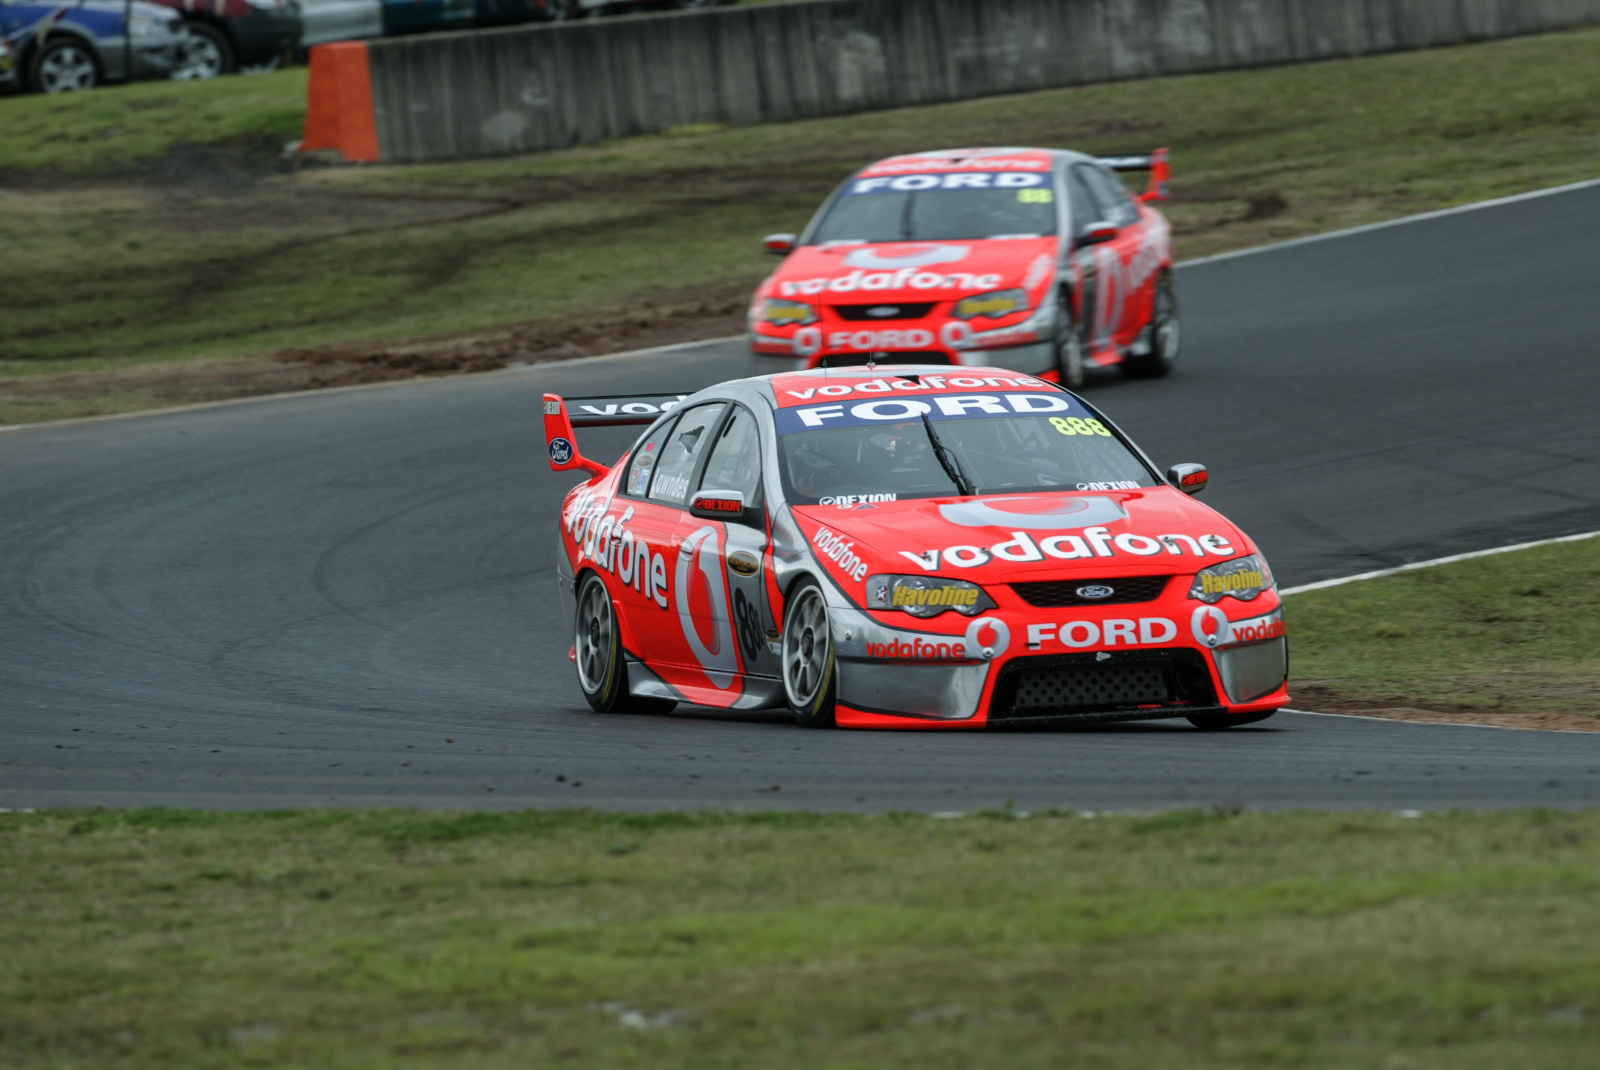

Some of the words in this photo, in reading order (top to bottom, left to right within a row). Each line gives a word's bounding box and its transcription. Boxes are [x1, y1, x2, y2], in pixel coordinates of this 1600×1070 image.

[853, 172, 1043, 194] FORD
[780, 267, 1003, 296] vodafone
[828, 329, 934, 348] FORD
[786, 376, 1045, 400] vodafone
[795, 394, 1070, 428] FORD
[1048, 416, 1113, 438] 888
[552, 440, 570, 461] Ford
[650, 466, 690, 499] Lowndes
[1089, 480, 1142, 491] DEXION
[704, 498, 741, 512] DEXION
[836, 493, 897, 505] DEXION
[567, 486, 669, 610] vodafone
[812, 526, 868, 584] vodafone
[897, 526, 1236, 572] vodafone
[1083, 585, 1106, 597] Ford
[1200, 568, 1264, 595] Havoline
[891, 584, 981, 607] Havoline
[1026, 616, 1178, 650] FORD
[865, 638, 966, 659] vodafone
